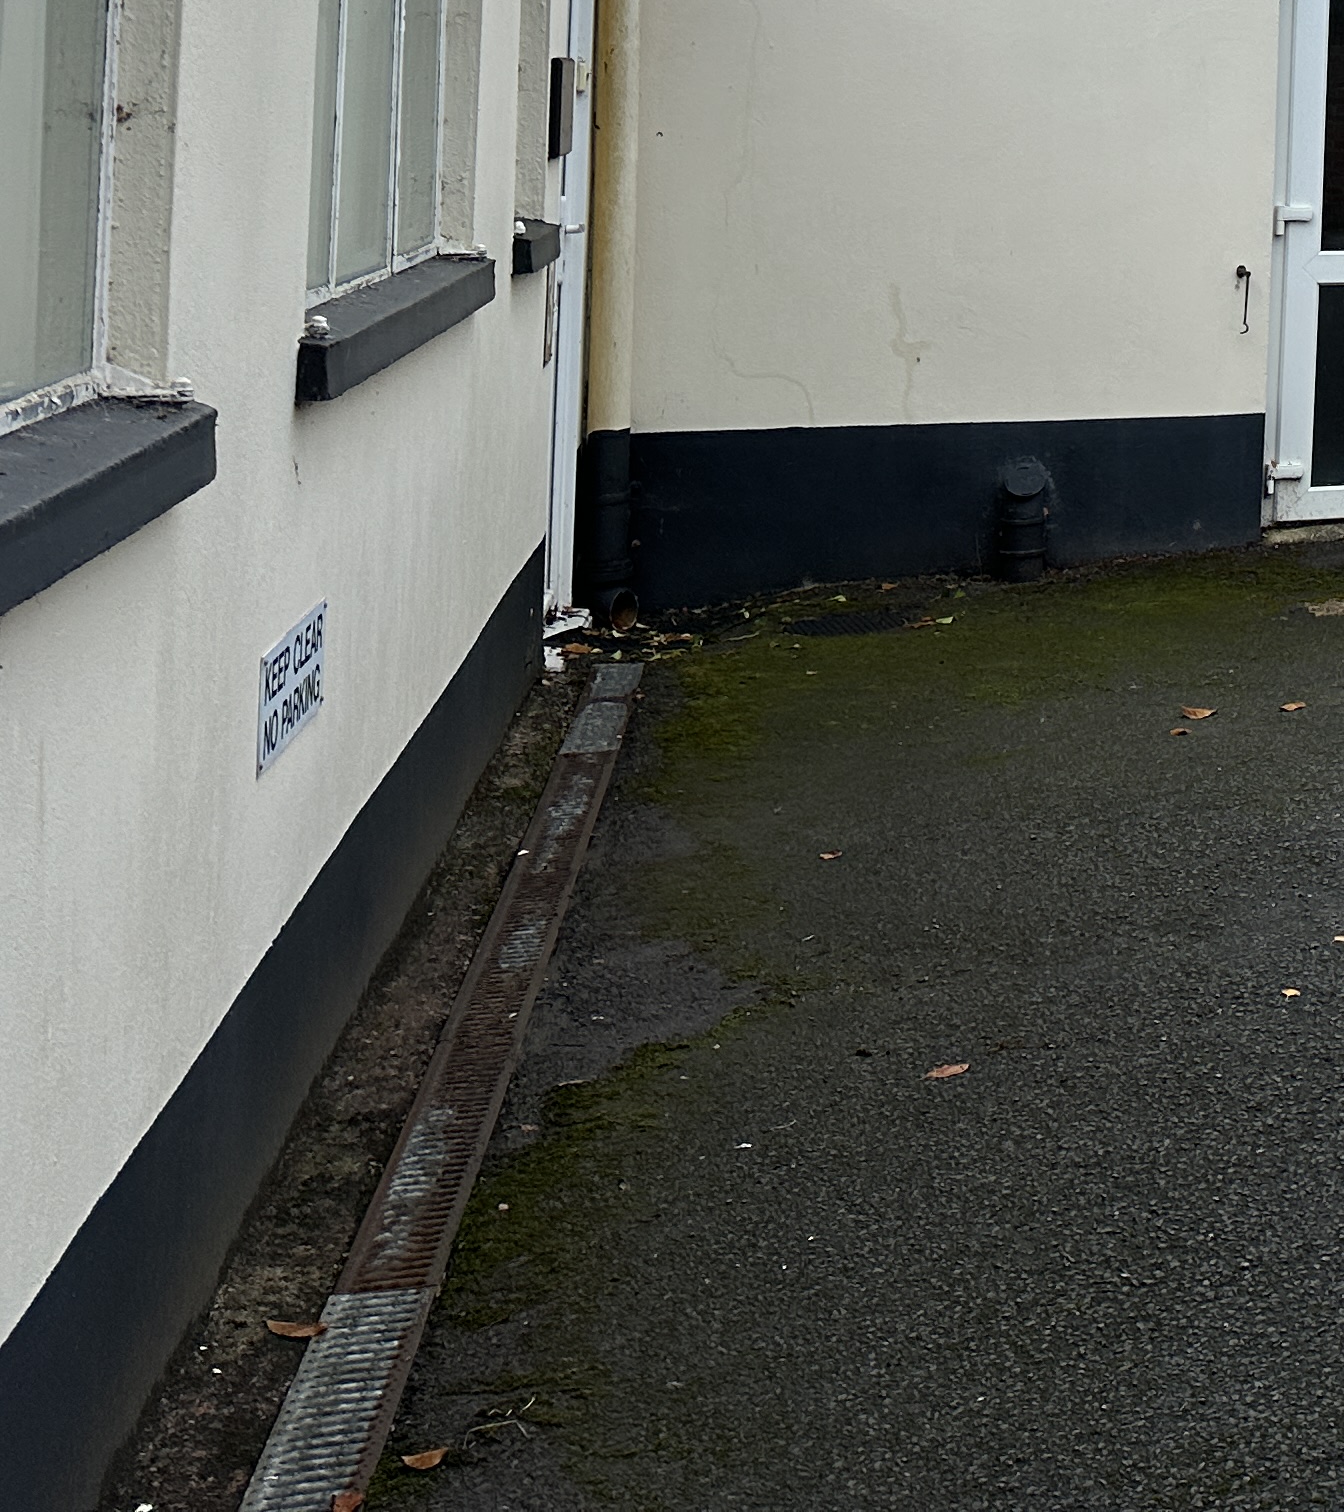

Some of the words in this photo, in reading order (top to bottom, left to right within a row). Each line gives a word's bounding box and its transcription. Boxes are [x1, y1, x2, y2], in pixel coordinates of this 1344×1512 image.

[264, 646, 291, 707] KEEP
[293, 613, 323, 675] CLEAR
[263, 709, 279, 761] NO
[281, 663, 321, 740] PARKING
